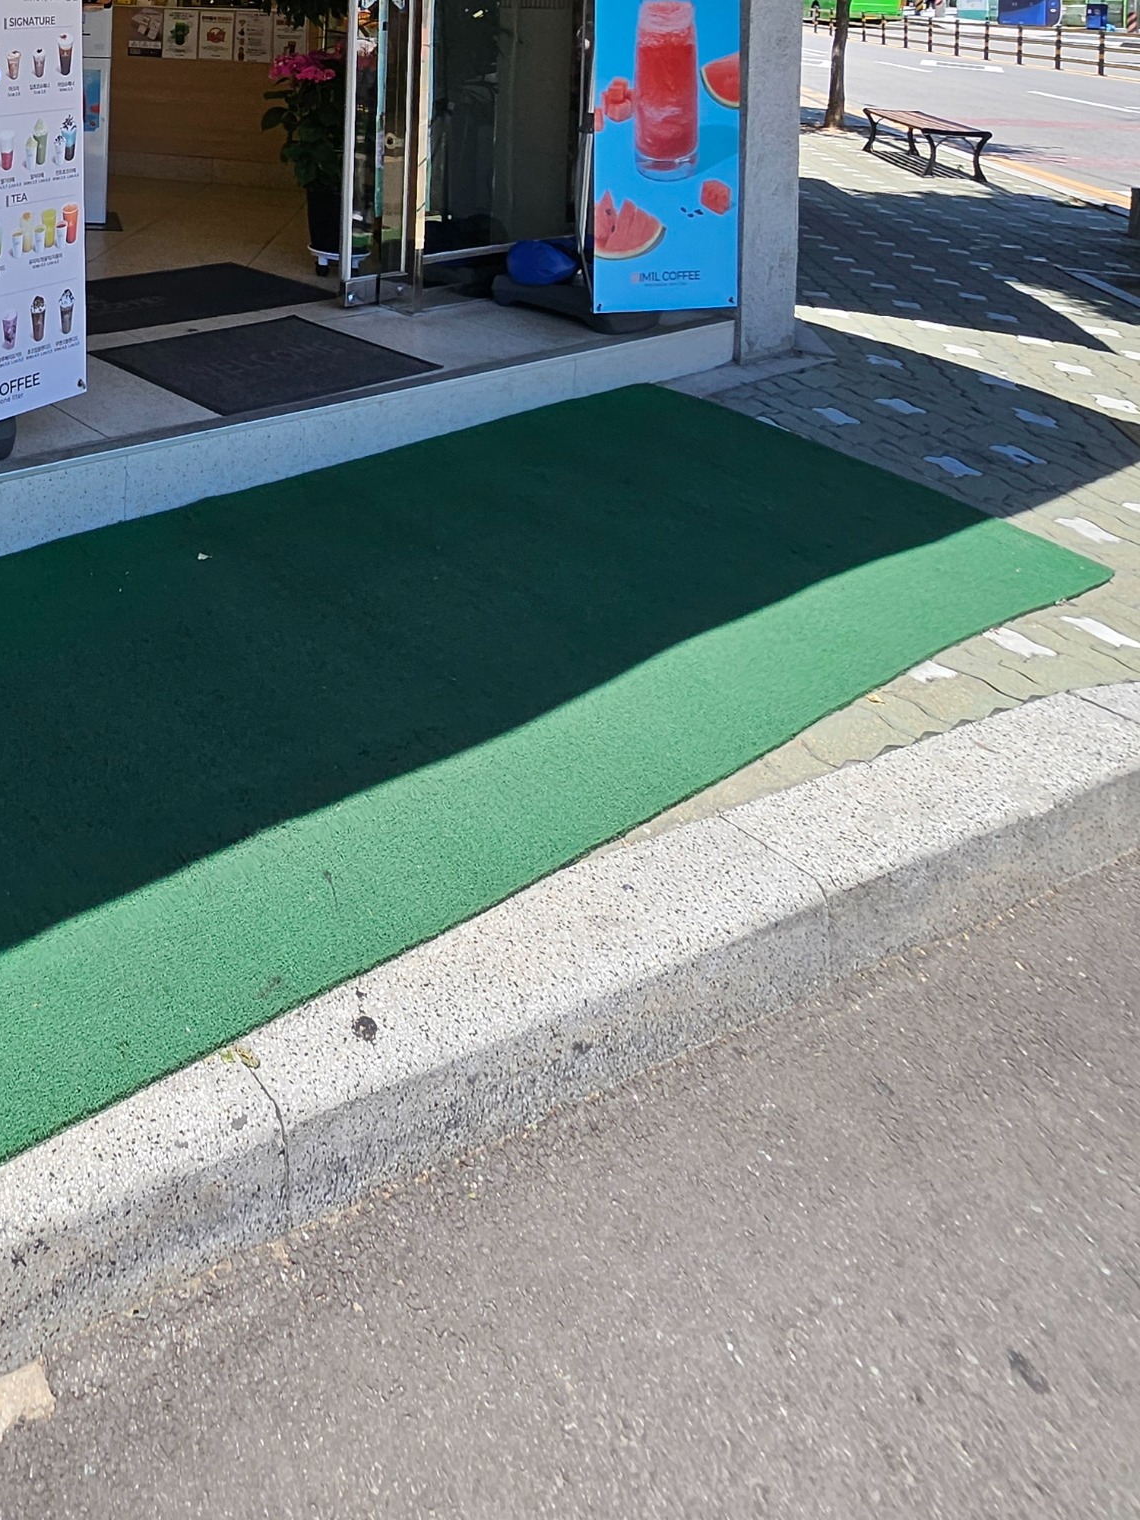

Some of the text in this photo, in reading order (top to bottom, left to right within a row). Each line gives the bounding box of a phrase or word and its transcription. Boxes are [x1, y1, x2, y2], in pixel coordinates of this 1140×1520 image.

[9, 16, 56, 27] SIGNATURE
[11, 193, 28, 204] TEA
[662, 270, 701, 281] COFFEE
